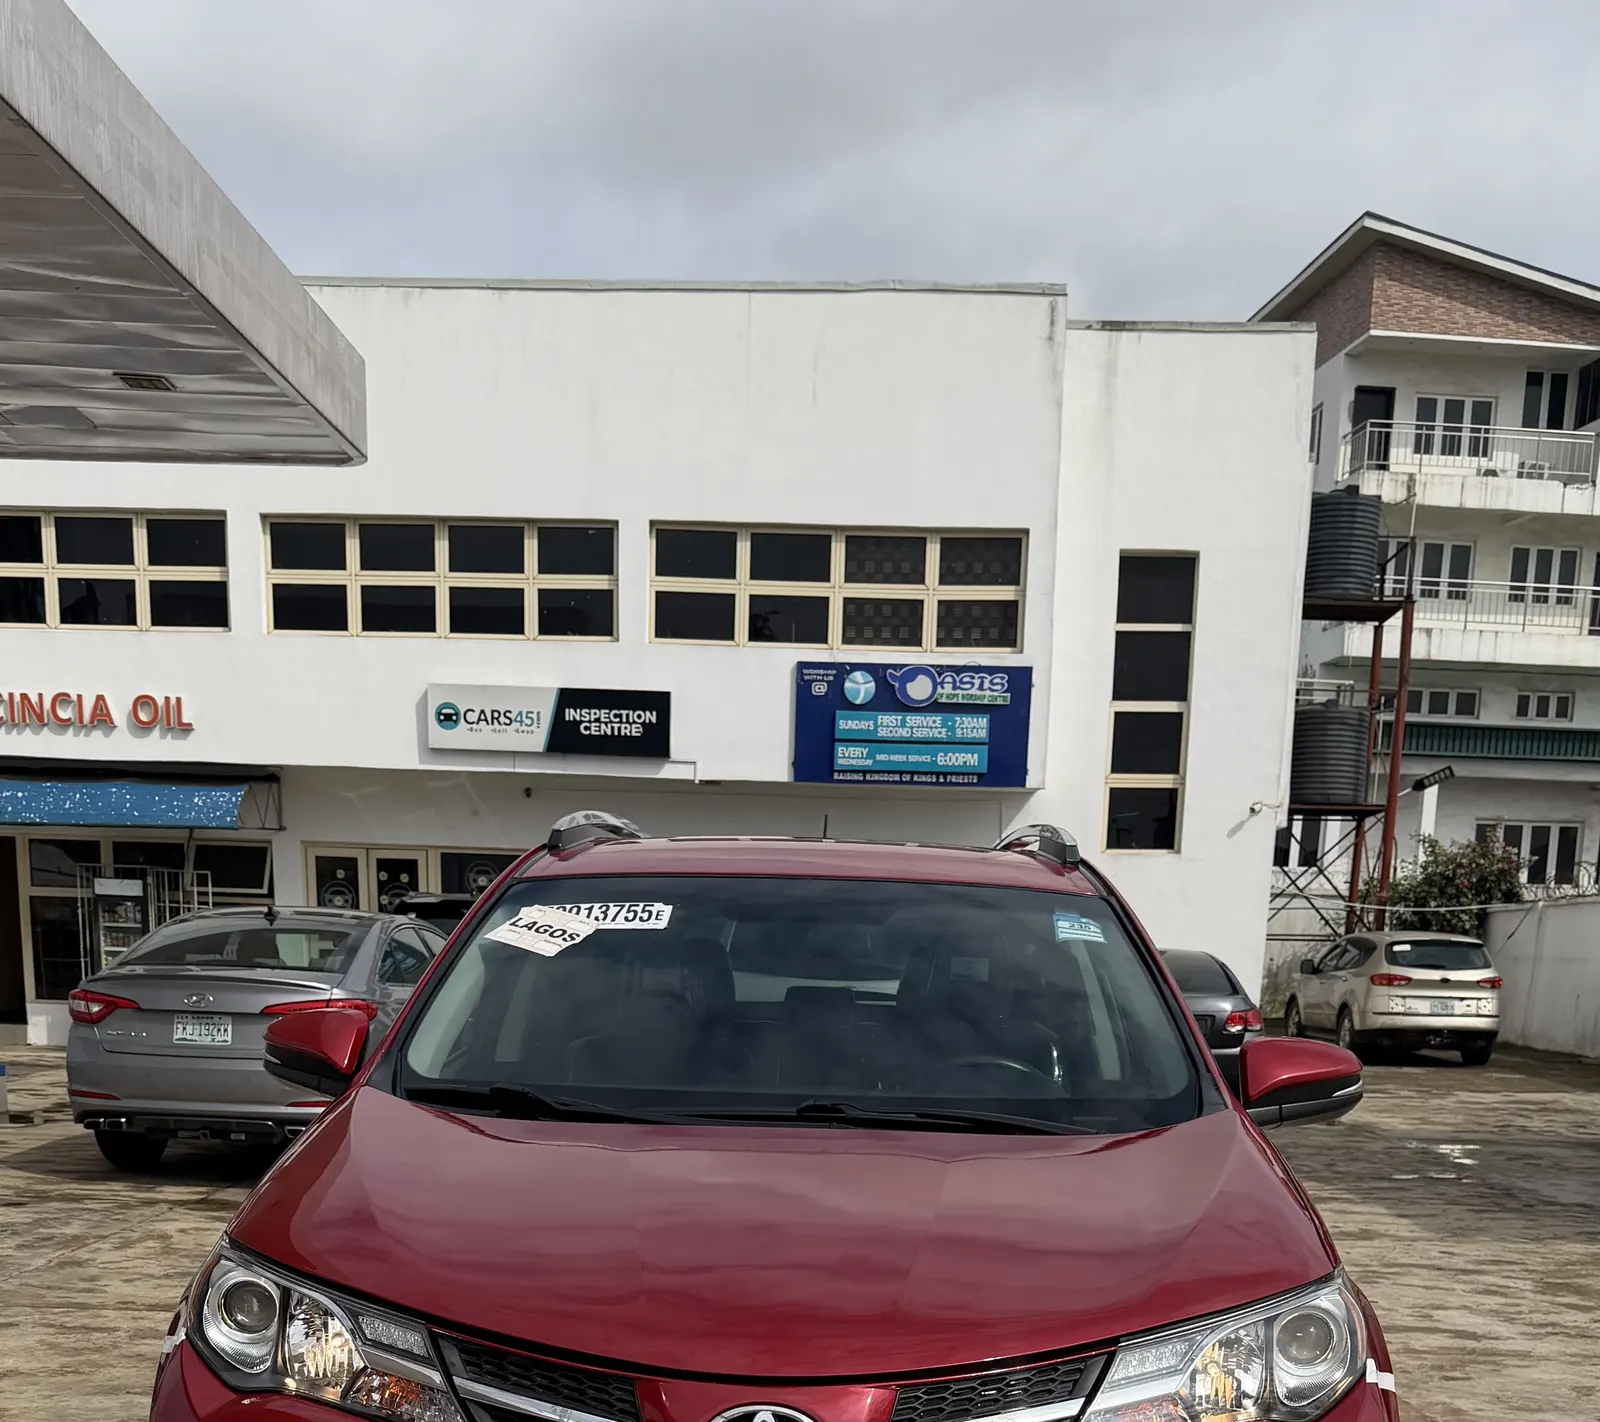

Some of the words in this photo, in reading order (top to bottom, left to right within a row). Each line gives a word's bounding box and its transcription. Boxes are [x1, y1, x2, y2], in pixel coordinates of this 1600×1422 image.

[0, 691, 115, 727] INCIA
[131, 694, 194, 730] OIL
[564, 708, 657, 724] INSPECTION
[839, 720, 874, 730] SUNDAYS
[877, 715, 902, 727] FIRST
[905, 716, 942, 728] SERVICE
[955, 717, 987, 729] 7:30AM
[579, 722, 643, 737] CENTRE
[877, 727, 911, 737] SECOND
[955, 728, 986, 738] 9:15AM
[837, 747, 869, 758] EVERY
[937, 752, 979, 767] 6:00PM
[833, 772, 864, 781] RAISING
[902, 774, 911, 782] OF
[509, 917, 581, 943] LAGOS
